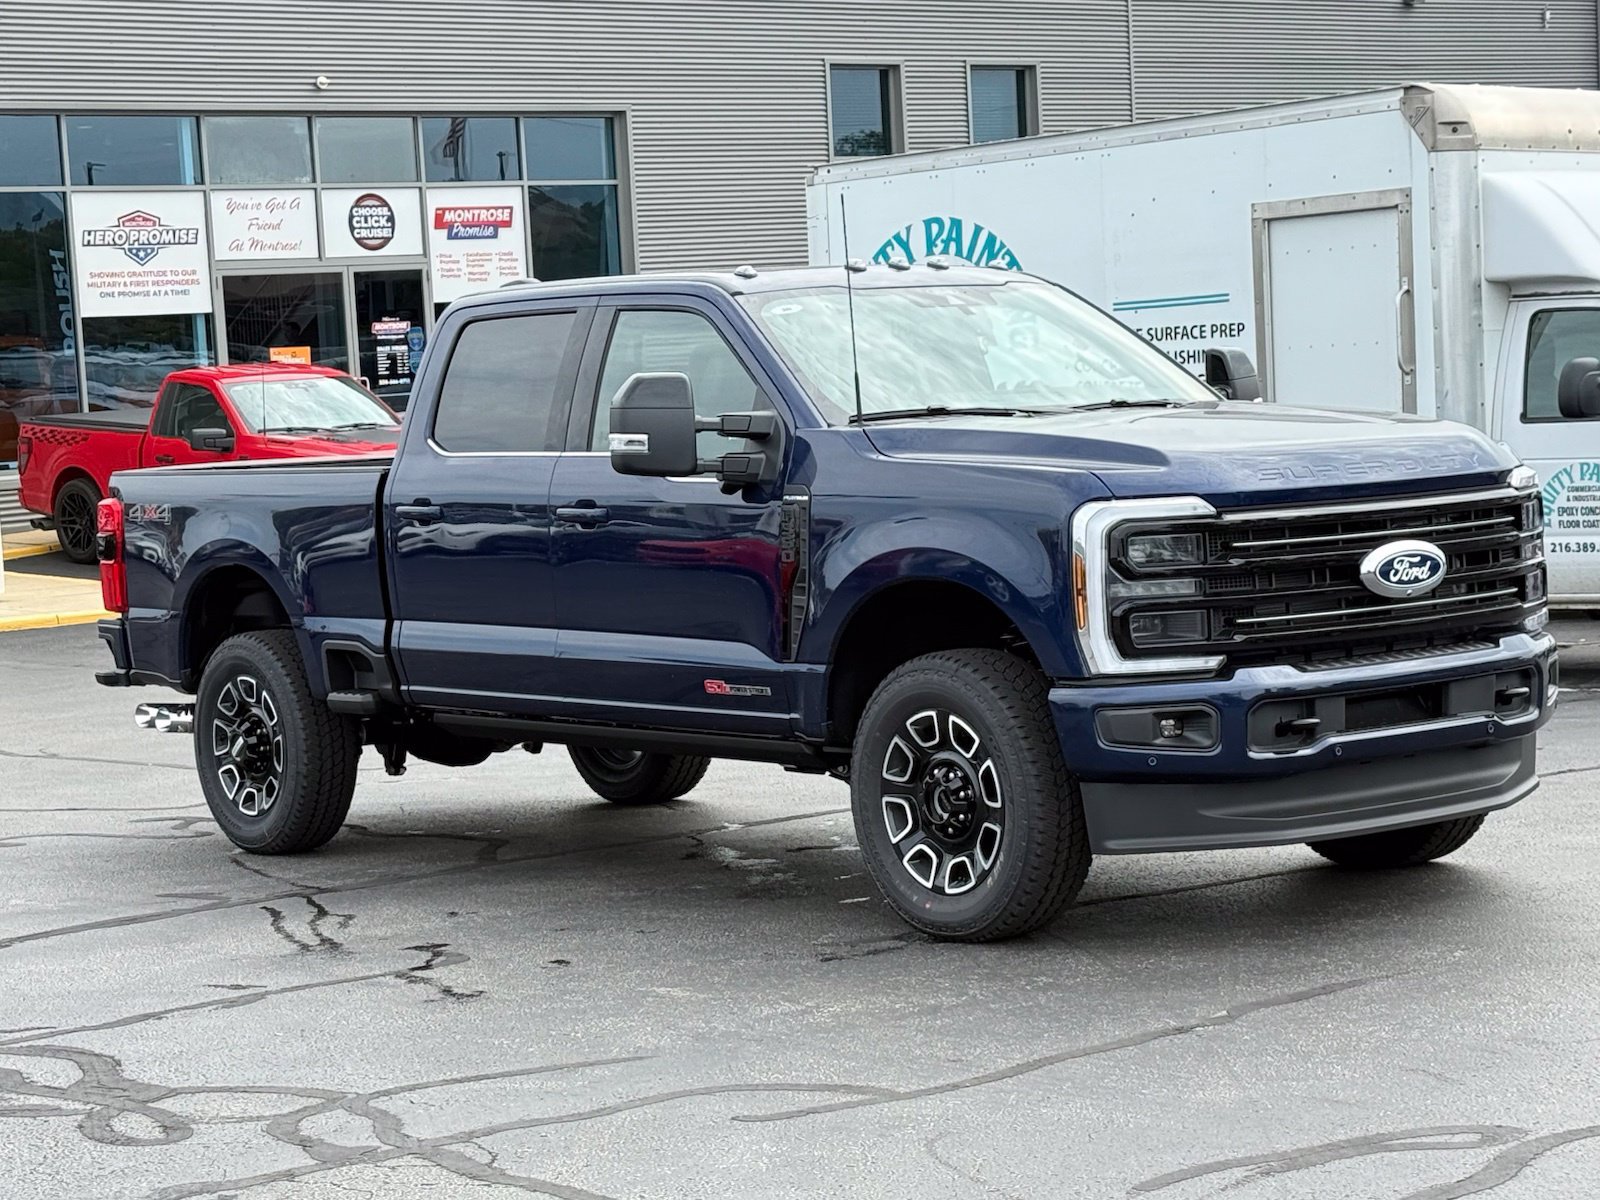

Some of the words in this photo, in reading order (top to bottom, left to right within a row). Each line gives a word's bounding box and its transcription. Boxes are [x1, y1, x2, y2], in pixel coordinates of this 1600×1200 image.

[225, 197, 262, 215] You've
[265, 197, 287, 214] Got
[289, 197, 301, 210] A
[352, 216, 391, 228] CLICK.
[443, 208, 511, 223] MONTROSE
[247, 217, 284, 231] Friend
[451, 222, 495, 237] Promise
[83, 230, 127, 246] HERO
[128, 228, 198, 245] PROMISE
[353, 228, 392, 238] CRUISE!
[228, 238, 245, 252] At
[248, 236, 302, 252] Montrose!
[89, 271, 126, 279] SHOWING
[126, 270, 168, 278] GRATITUDE
[86, 281, 122, 289] MILITARY
[129, 280, 150, 288] FIRST
[151, 279, 200, 287] RESPONDERS
[1146, 324, 1207, 342] SURFACE
[1210, 322, 1245, 339] PREP
[1258, 461, 1394, 482] SUPER
[1397, 454, 1479, 473] DUTY
[1557, 506, 1579, 516] EPOXY
[1558, 520, 1580, 528] FLOOR
[1389, 556, 1431, 582] Ford
